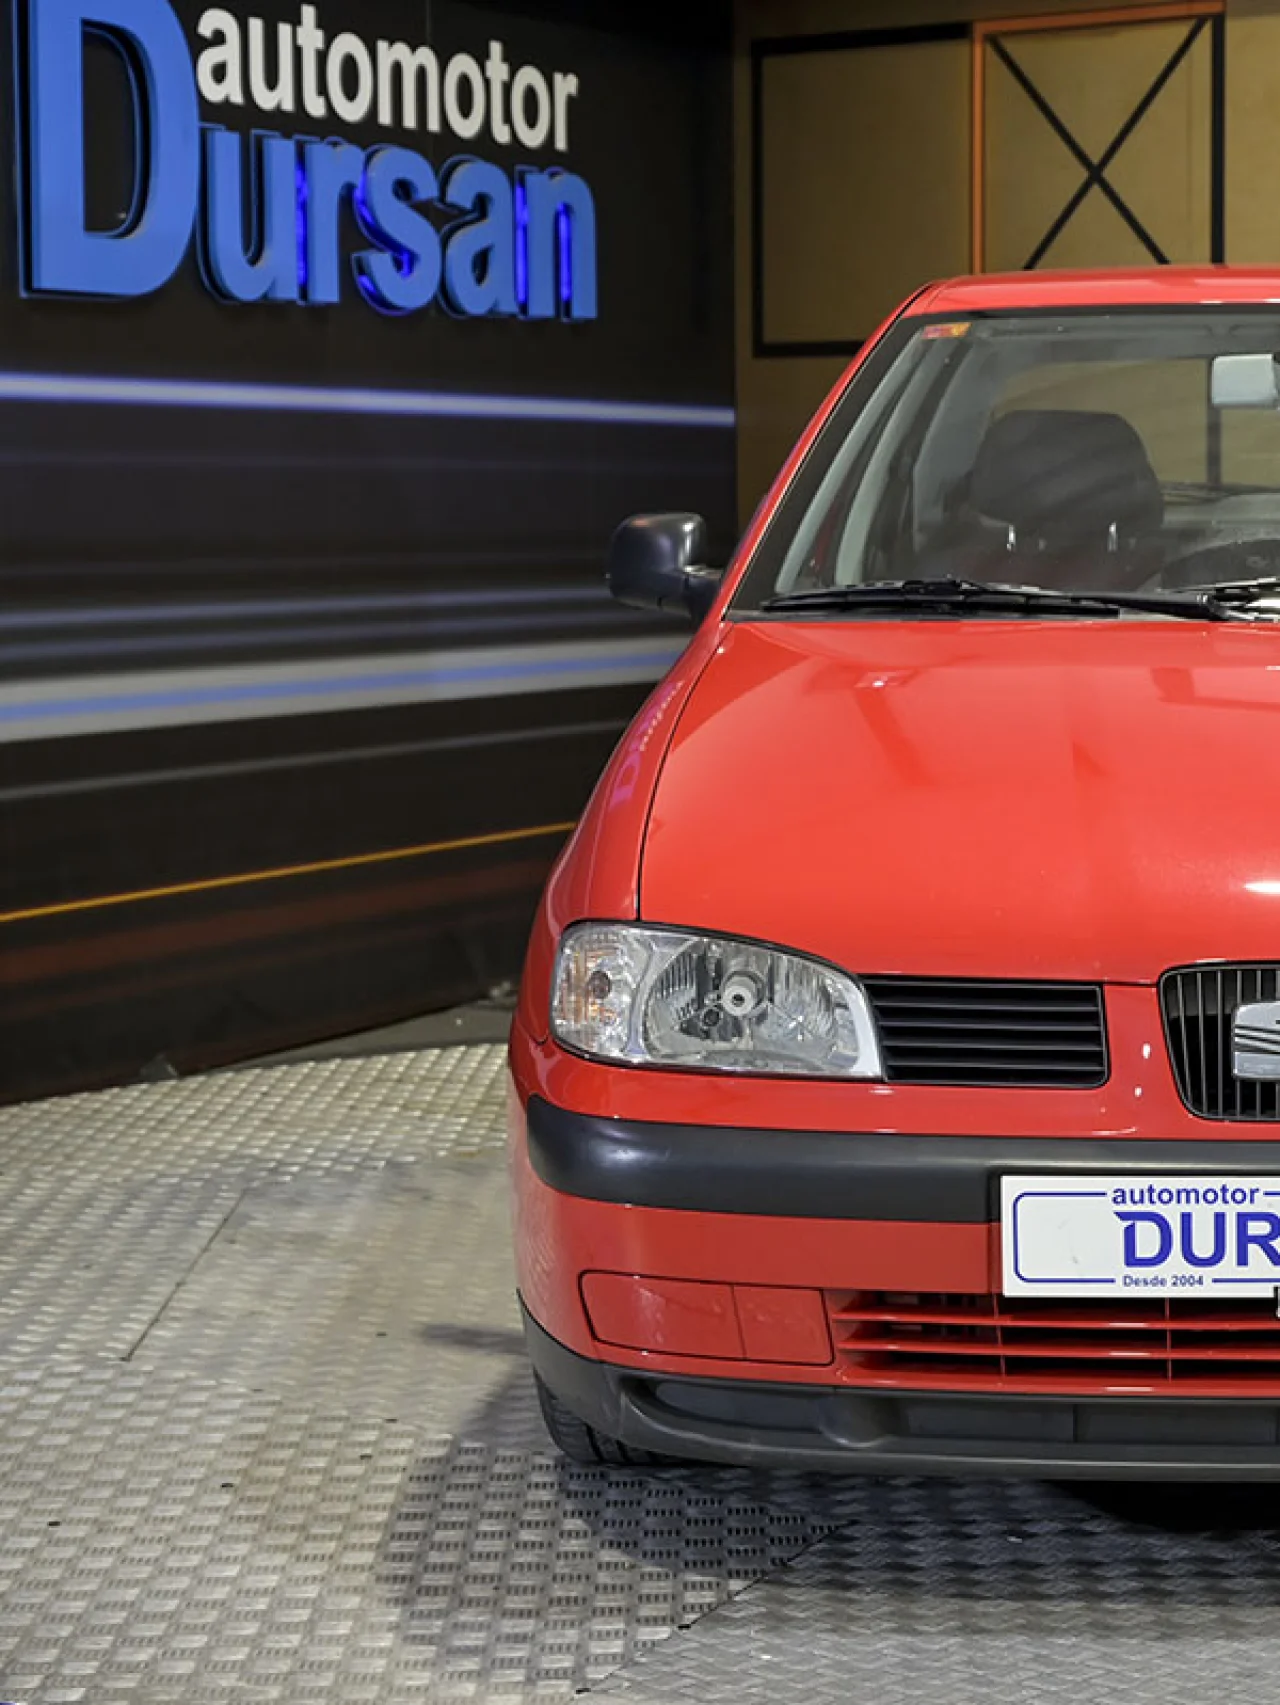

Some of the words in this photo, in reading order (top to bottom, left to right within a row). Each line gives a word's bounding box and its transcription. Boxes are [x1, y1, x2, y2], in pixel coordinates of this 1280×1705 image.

[197, 5, 578, 151] automotor
[18, 0, 597, 319] Dursan
[1112, 1184, 1260, 1206] automotor
[1122, 1274, 1168, 1288] Desde
[1170, 1274, 1204, 1288] 2004
